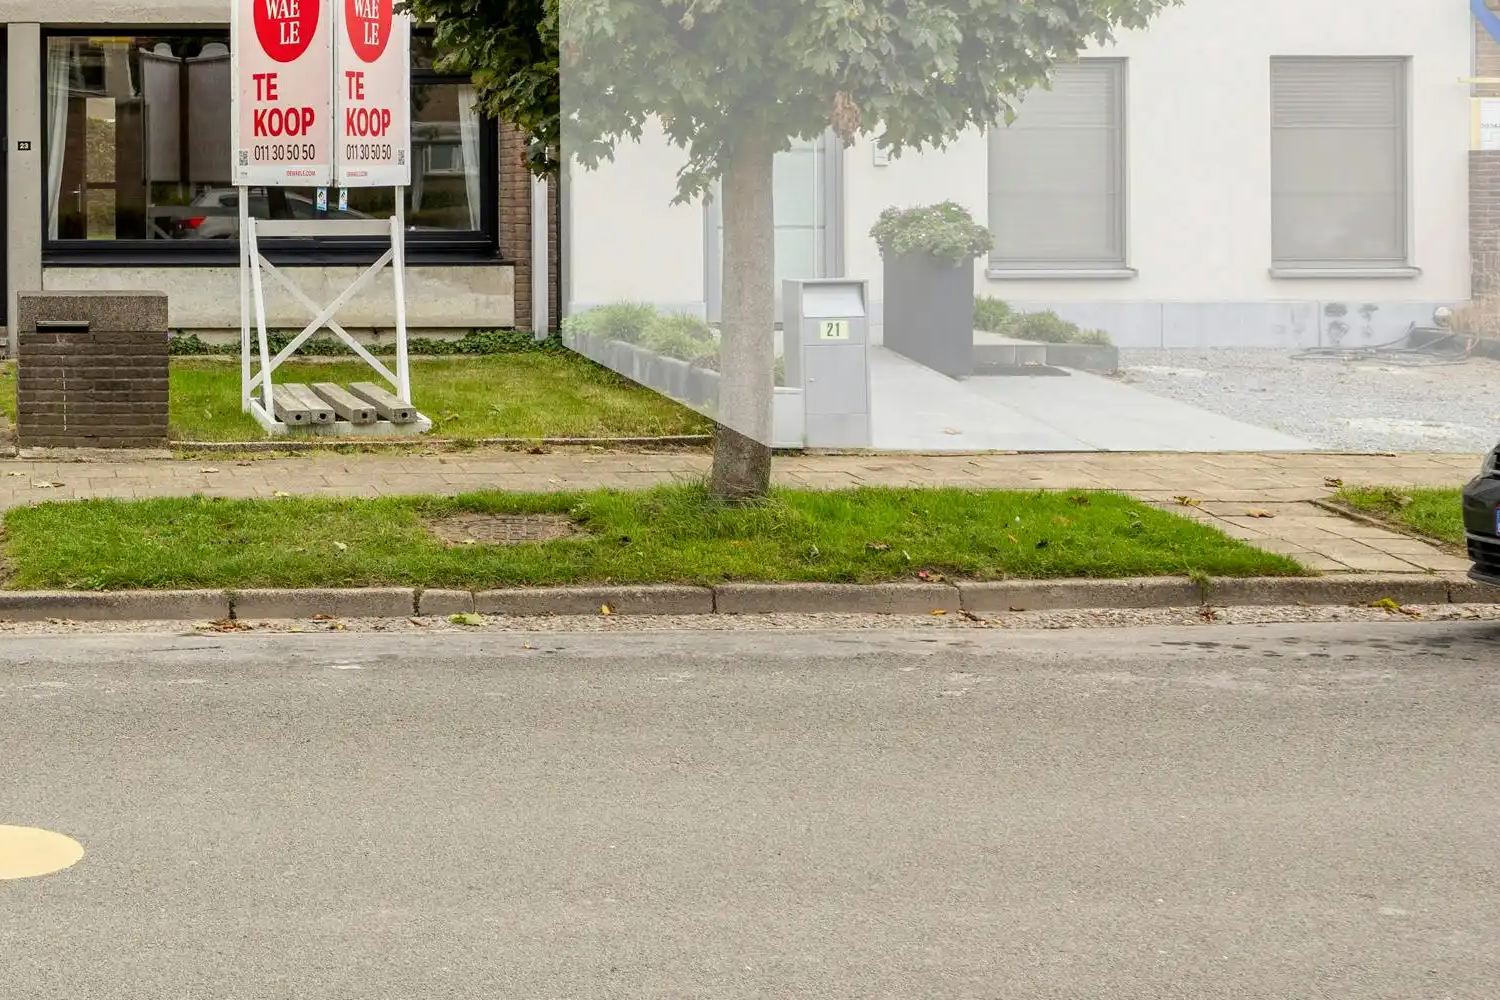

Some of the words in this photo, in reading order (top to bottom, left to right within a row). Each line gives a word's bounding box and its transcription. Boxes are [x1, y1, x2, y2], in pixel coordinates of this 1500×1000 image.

[279, 21, 300, 45] LE
[364, 21, 380, 45] LE
[252, 73, 278, 101] TE
[345, 70, 365, 100] TE
[253, 107, 315, 137] KOOP
[346, 107, 391, 137] KOOP
[254, 145, 269, 160] 011
[272, 144, 284, 160] 30
[286, 144, 300, 160] 50
[302, 143, 315, 160] 50
[346, 144, 358, 160] 011
[360, 144, 369, 160] 30
[371, 144, 380, 160] 50
[382, 144, 391, 160] 50
[827, 322, 840, 337] 21
